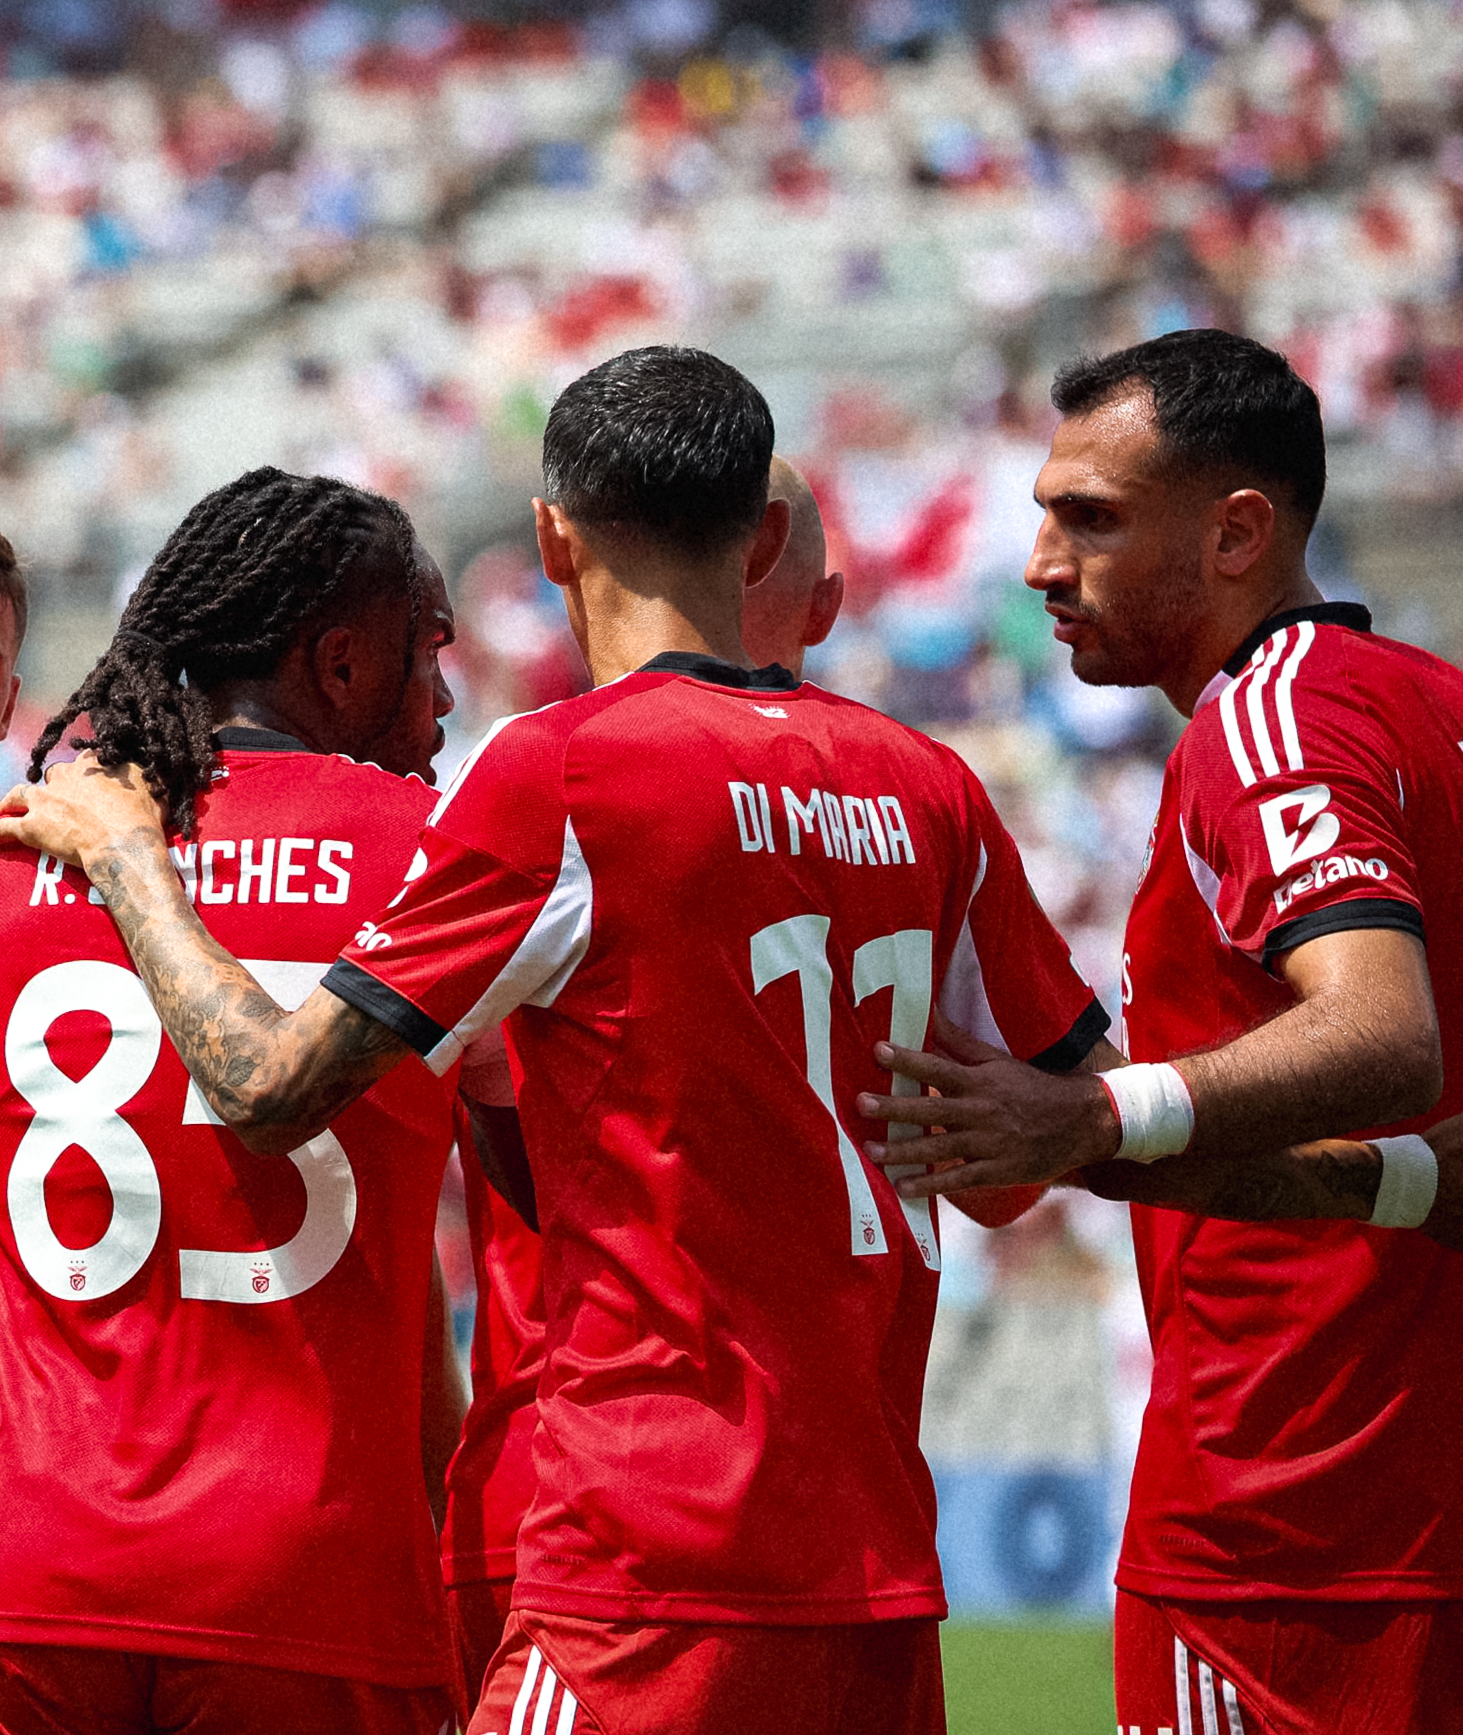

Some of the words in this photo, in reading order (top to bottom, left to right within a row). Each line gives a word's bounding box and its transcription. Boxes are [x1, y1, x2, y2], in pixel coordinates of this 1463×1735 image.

[727, 781, 776, 854] DI
[780, 785, 917, 866] MARIA
[28, 850, 76, 906] R.
[88, 837, 354, 905] NCHES
[749, 914, 941, 1272] 11
